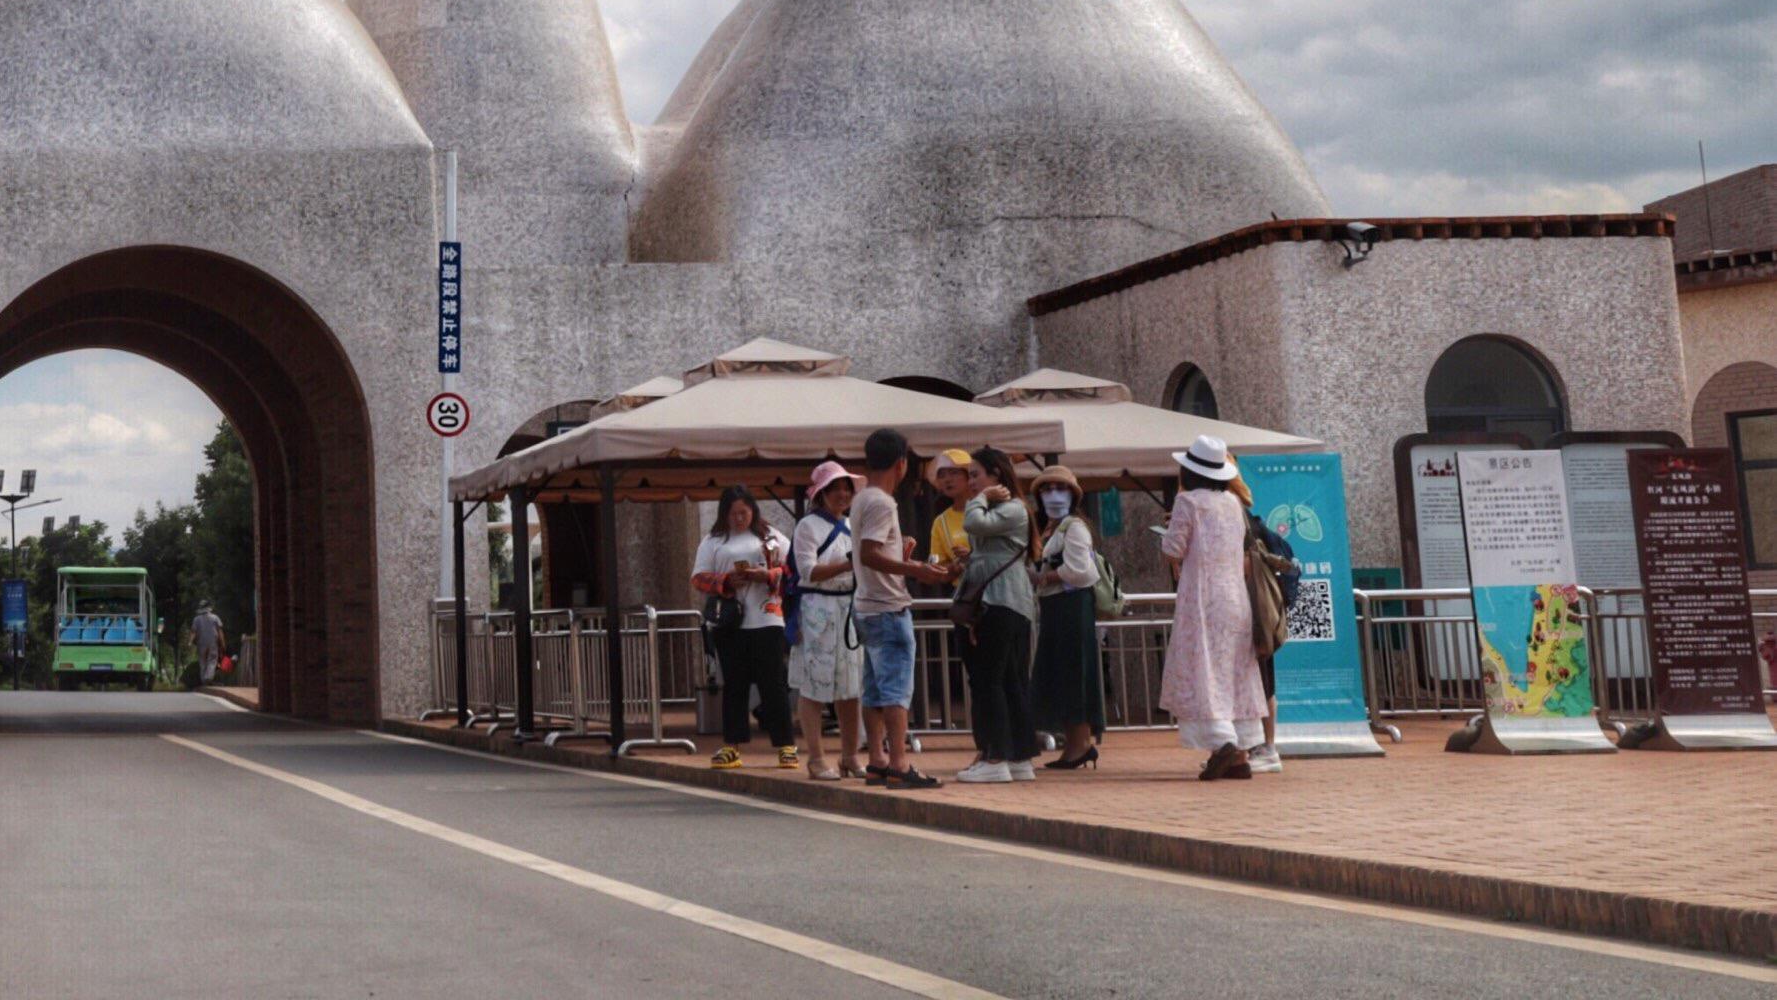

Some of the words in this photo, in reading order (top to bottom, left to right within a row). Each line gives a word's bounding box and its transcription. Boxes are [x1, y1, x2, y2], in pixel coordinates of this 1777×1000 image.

[441, 246, 458, 368] 全路段禁止停车
[438, 402, 459, 428] 30
[1488, 456, 1533, 470] 景区公告
